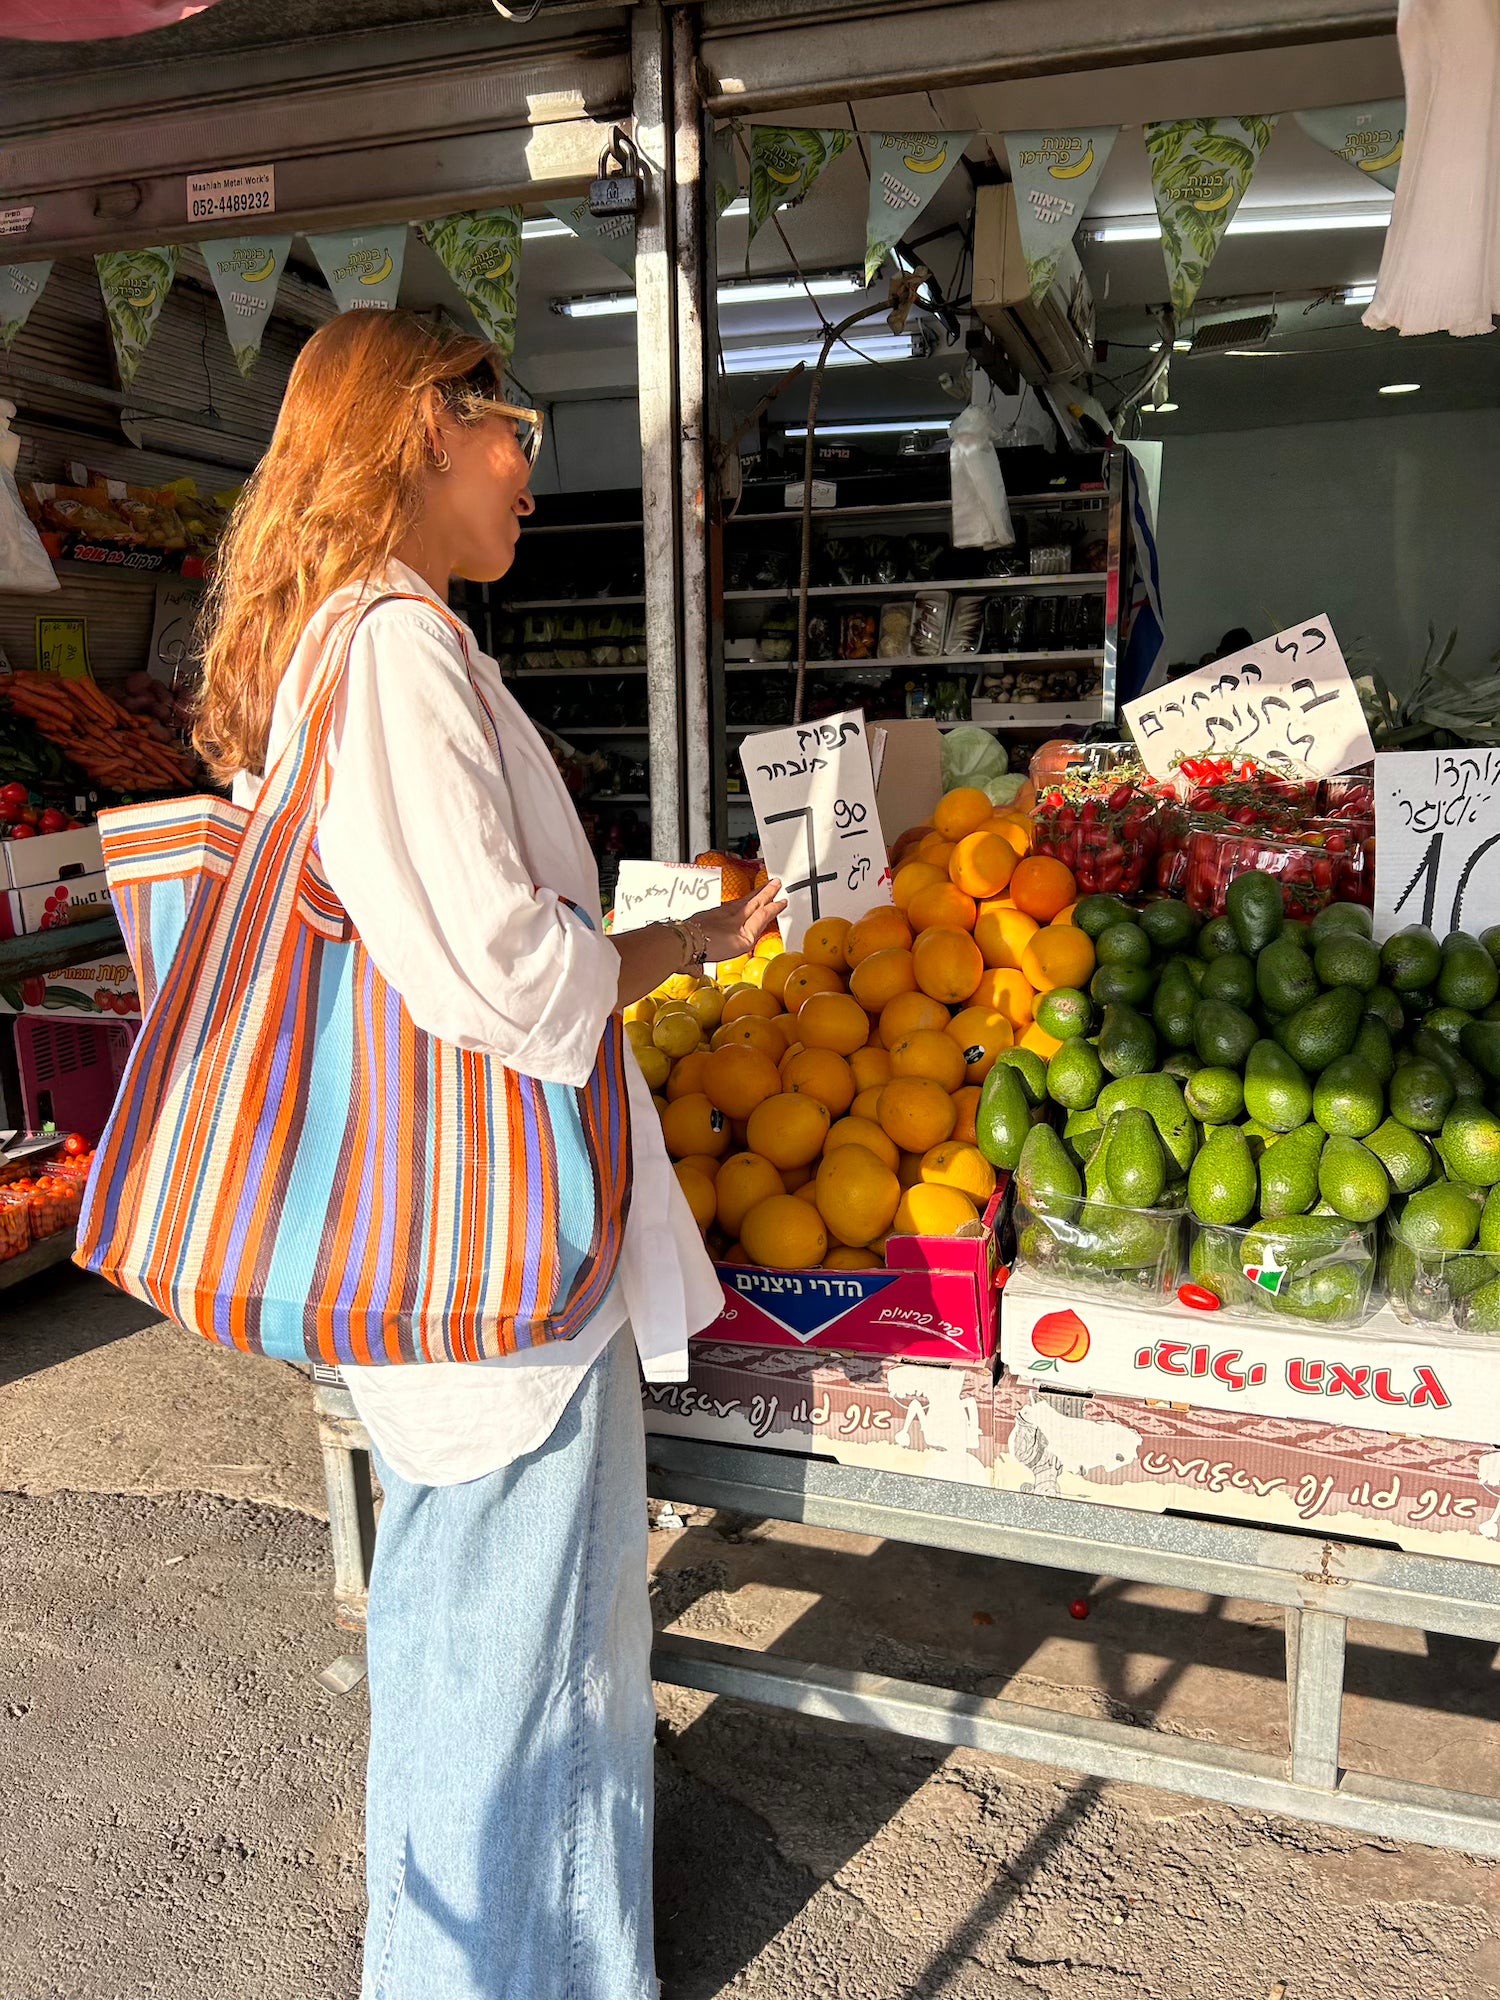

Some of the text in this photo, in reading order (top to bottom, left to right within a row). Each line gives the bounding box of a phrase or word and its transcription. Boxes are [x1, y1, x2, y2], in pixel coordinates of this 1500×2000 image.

[880, 133, 925, 157] פרידמן
[1042, 136, 1082, 151] בננות
[1345, 129, 1392, 146] בננות
[770, 143, 798, 168] בננות
[1019, 150, 1070, 168] פרידמן
[223, 178, 243, 188] Metal
[244, 175, 270, 185] Work's
[880, 171, 921, 207] טעימות
[1187, 173, 1224, 187] בננות
[193, 191, 269, 216] 052-4489232
[883, 188, 906, 209] יותר
[1028, 189, 1075, 216] בריאות
[1165, 186, 1213, 201] פרידמן
[1033, 206, 1062, 224] יותר
[233, 248, 265, 260] בננות
[348, 248, 381, 265] בננות
[472, 246, 501, 264] בננות
[217, 260, 256, 276] פרידמן
[332, 261, 374, 284] פרידמן
[459, 259, 496, 281] פרידמן
[122, 278, 149, 289] בננות
[229, 291, 268, 310] טעימות
[235, 303, 257, 316] יותר
[350, 298, 389, 310] בריאות
[1276, 627, 1326, 662] כל
[796, 721, 860, 751] תפוז
[764, 799, 867, 921] 7 90
[735, 1273, 864, 1298] הדרי ניצנים
[878, 1306, 965, 1337] פרי פרמיום
[1134, 1338, 1452, 1410] יבולי הארץ
[640, 1381, 893, 1438] תוצרת של יום טוב
[1295, 1475, 1332, 1520] של
[1347, 1475, 1401, 1509] יום
[1407, 1487, 1480, 1521] טוב
